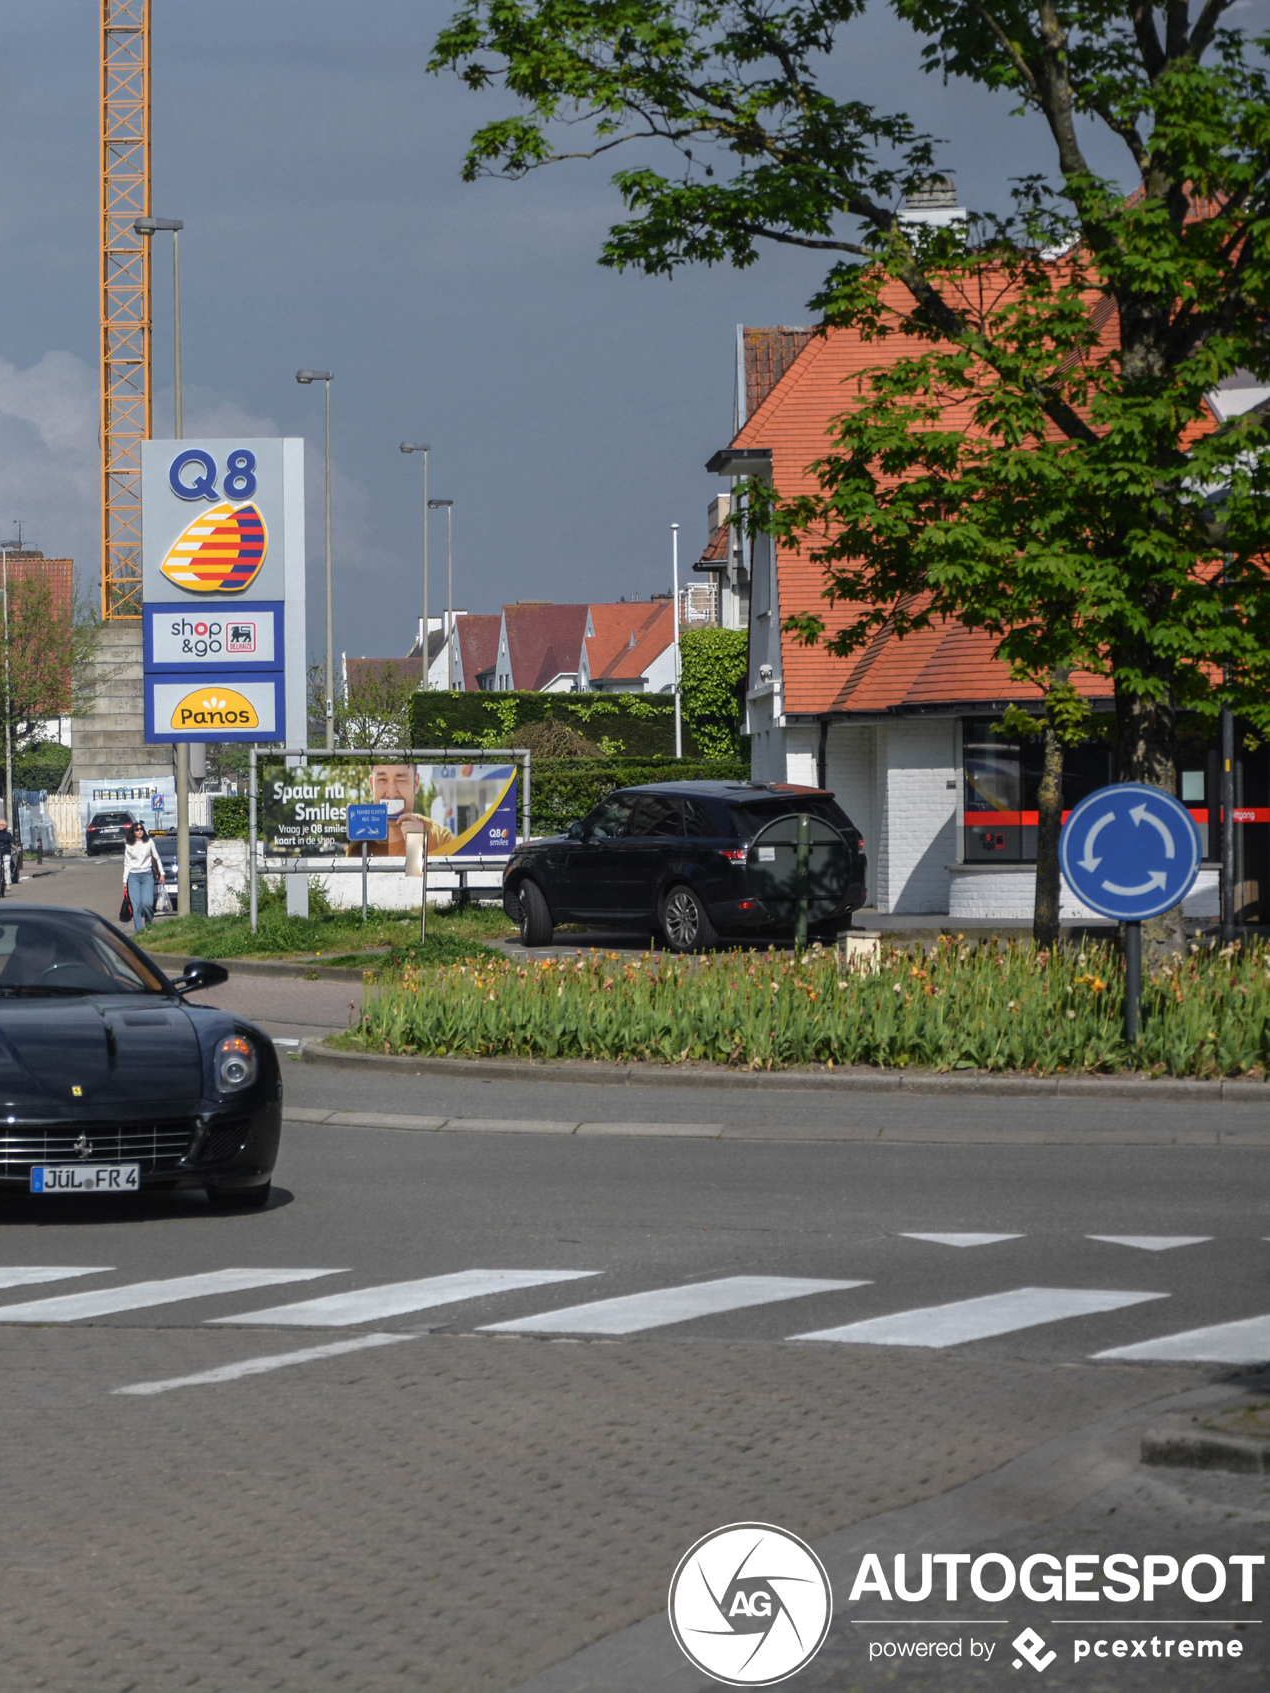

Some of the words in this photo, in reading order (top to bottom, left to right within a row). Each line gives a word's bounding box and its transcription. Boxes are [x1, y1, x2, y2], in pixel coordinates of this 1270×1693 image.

[169, 449, 257, 500] Q8
[171, 618, 222, 639] shop
[182, 639, 222, 657] &go
[180, 708, 250, 725] Panos
[273, 782, 320, 804] Spaar
[325, 786, 345, 799] nu
[295, 803, 347, 820] Smiles
[1233, 811, 1256, 821] itgang
[279, 825, 301, 835] Vraag
[302, 824, 309, 836] je
[310, 824, 322, 834] Q8
[489, 829, 501, 838] Q8
[274, 836, 296, 845] kaart
[297, 836, 305, 845] in
[306, 836, 315, 845] de
[317, 836, 337, 848] shop.
[44, 1169, 83, 1188] JÜL
[96, 1169, 121, 1188] FR
[125, 1168, 137, 1187] 4
